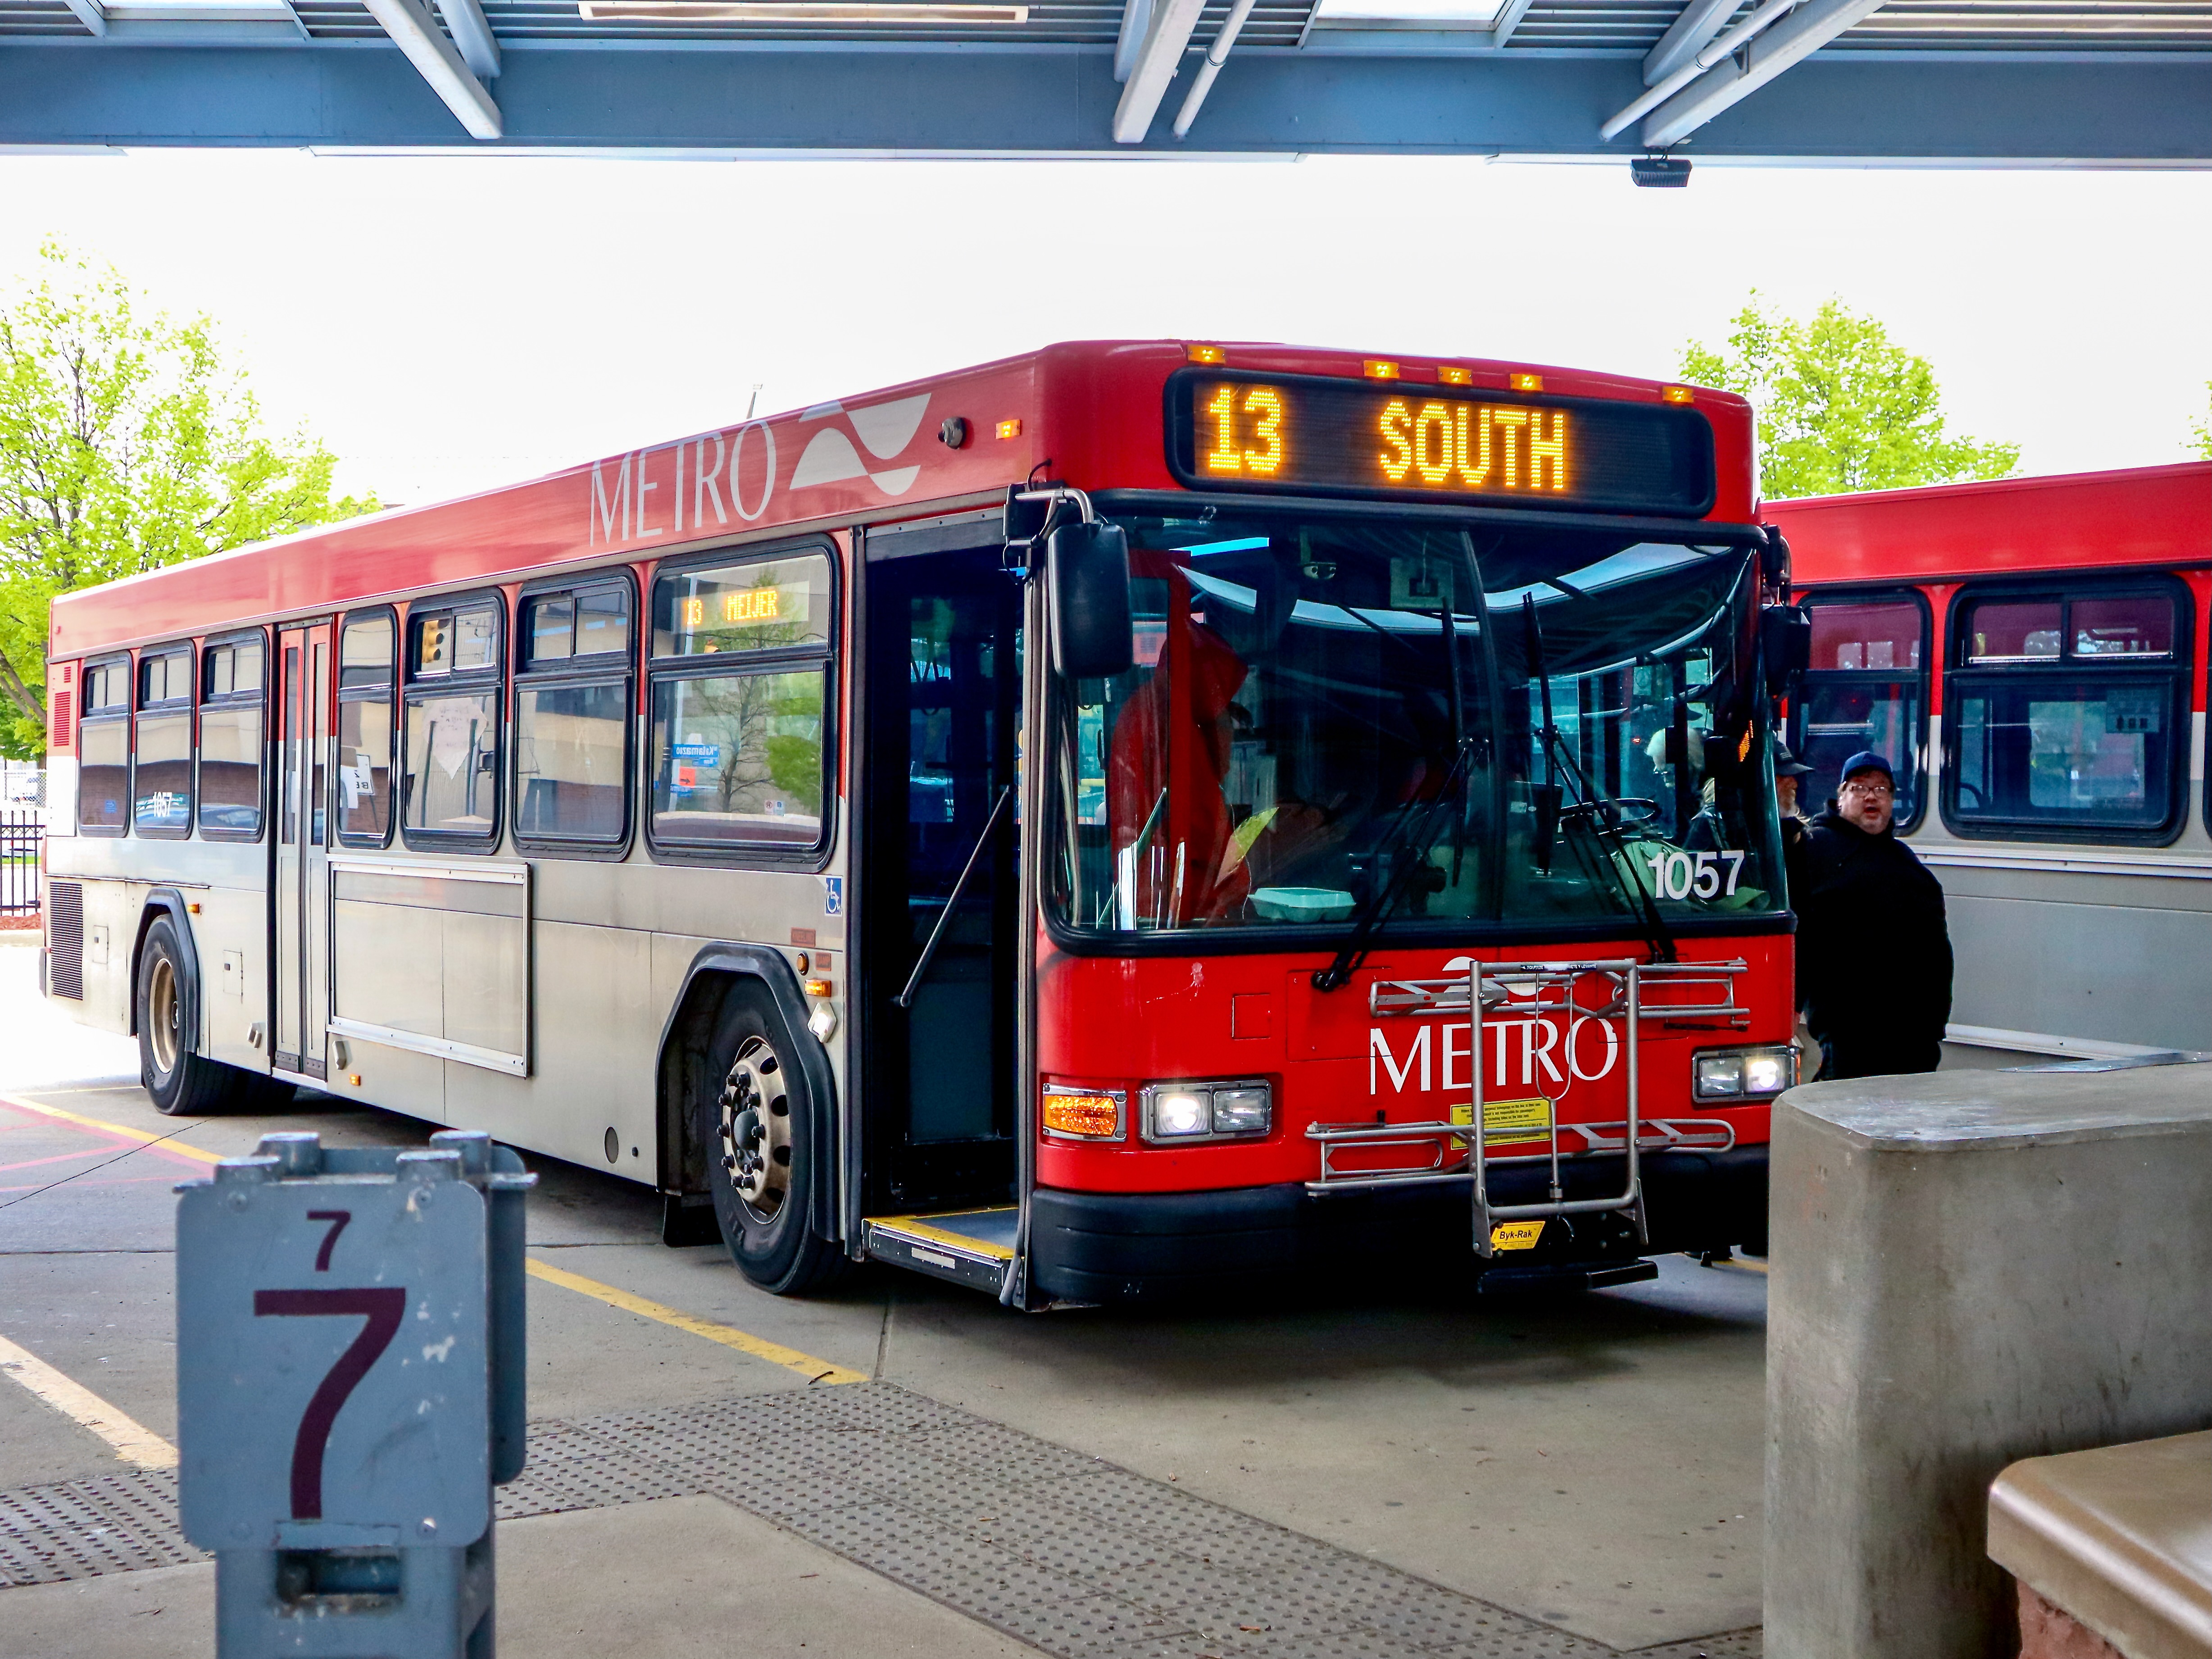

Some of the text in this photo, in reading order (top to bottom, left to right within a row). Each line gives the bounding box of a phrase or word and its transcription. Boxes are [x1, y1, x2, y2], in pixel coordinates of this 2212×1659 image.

[1208, 386, 1565, 490] 13 SOUTH
[589, 420, 777, 547] METRO
[686, 590, 777, 625] 13 MEIJER
[153, 791, 173, 818] 1057
[1647, 850, 1745, 901] 1057
[1370, 1016, 1618, 1095] METRO
[307, 1210, 351, 1271] 7
[1499, 1230, 1532, 1241] Byk-Rak
[254, 1287, 406, 1519] 7
